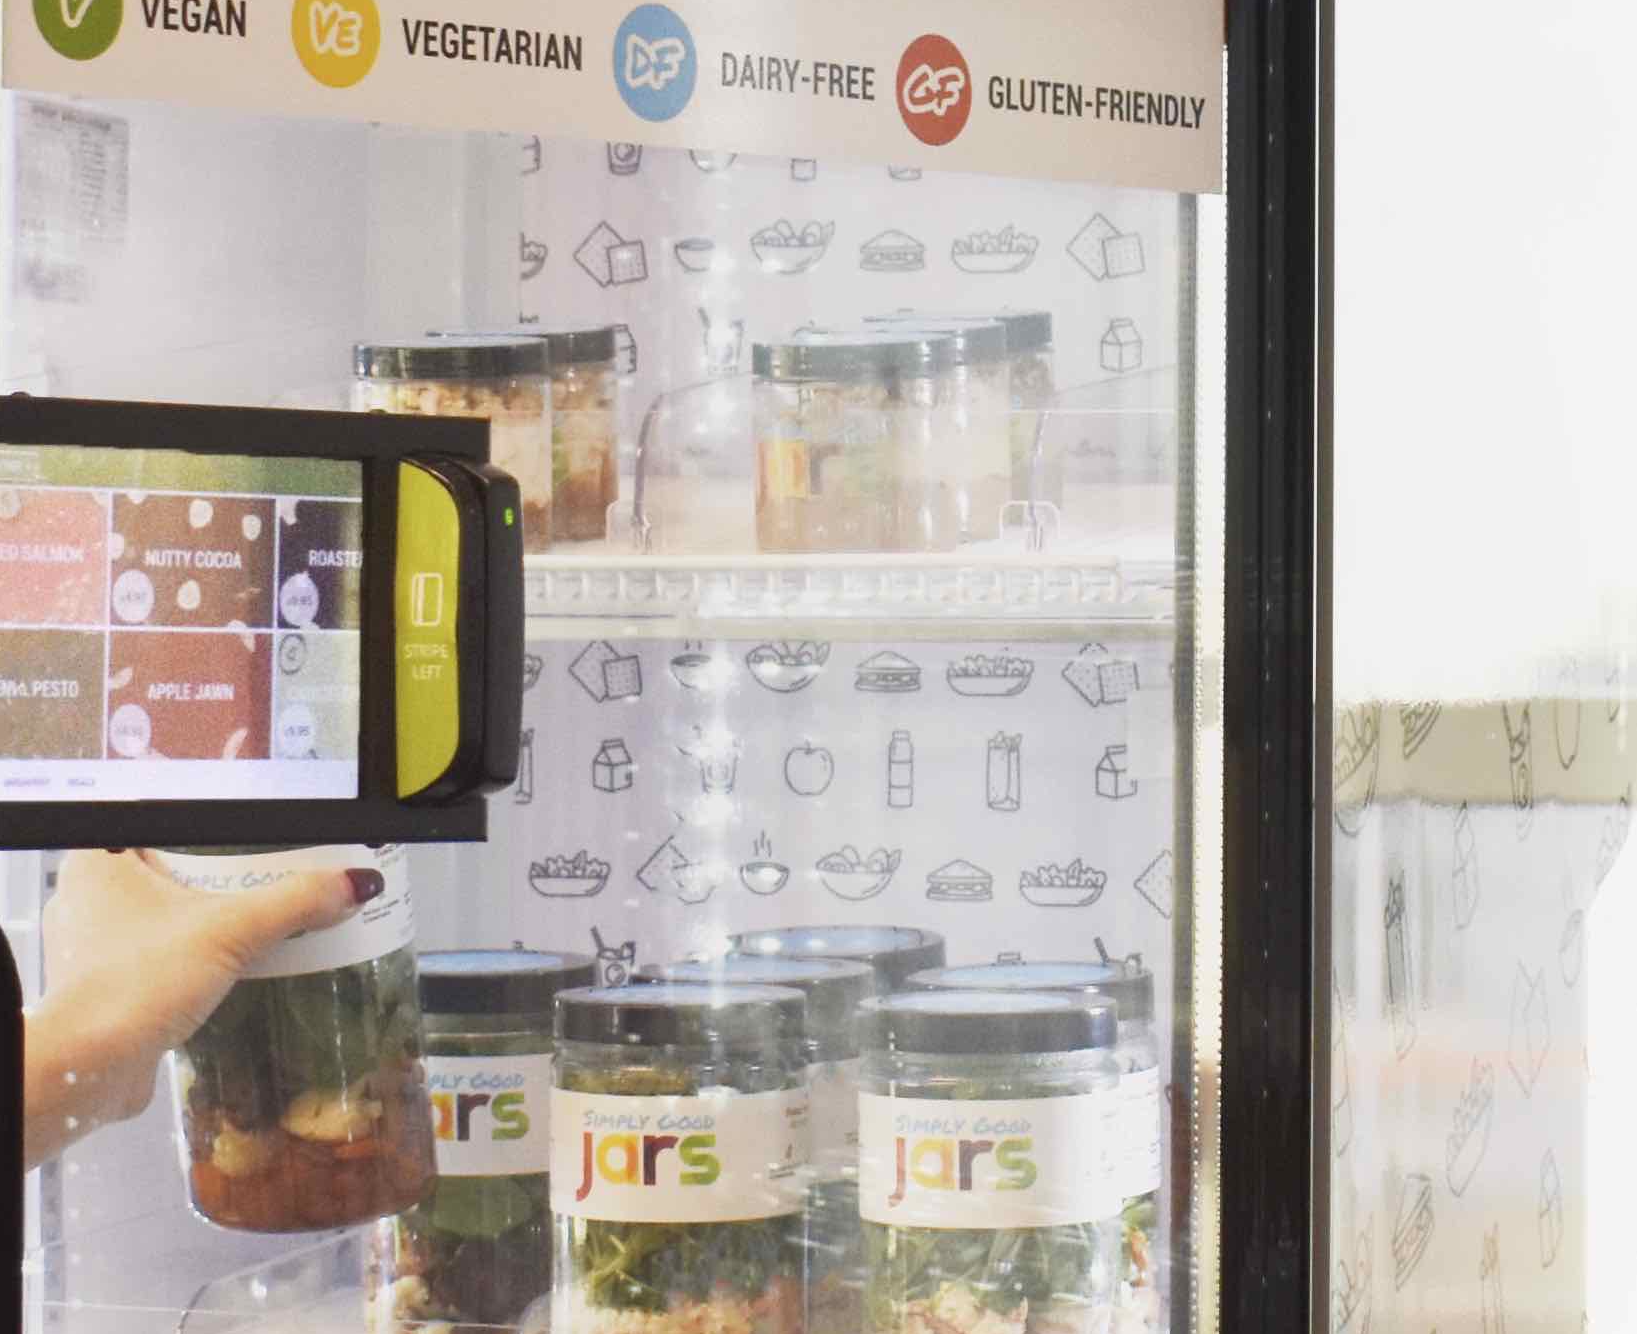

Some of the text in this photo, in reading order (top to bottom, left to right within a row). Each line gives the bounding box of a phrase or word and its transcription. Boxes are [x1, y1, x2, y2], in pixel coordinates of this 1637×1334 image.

[401, 18, 583, 71] VEGETARIAN
[720, 52, 875, 101] DAIRY-FREE
[988, 75, 1206, 130] GLUTEN-FRIENDLY
[144, 549, 242, 569] NUTTY COCOA
[404, 642, 449, 659] STRIPE
[412, 665, 443, 680] LEFT
[32, 679, 80, 698] PESTO
[147, 682, 191, 700] APPLE
[470, 1072, 525, 1089] GOOD
[583, 1109, 714, 1130] SIMPLY GOOD
